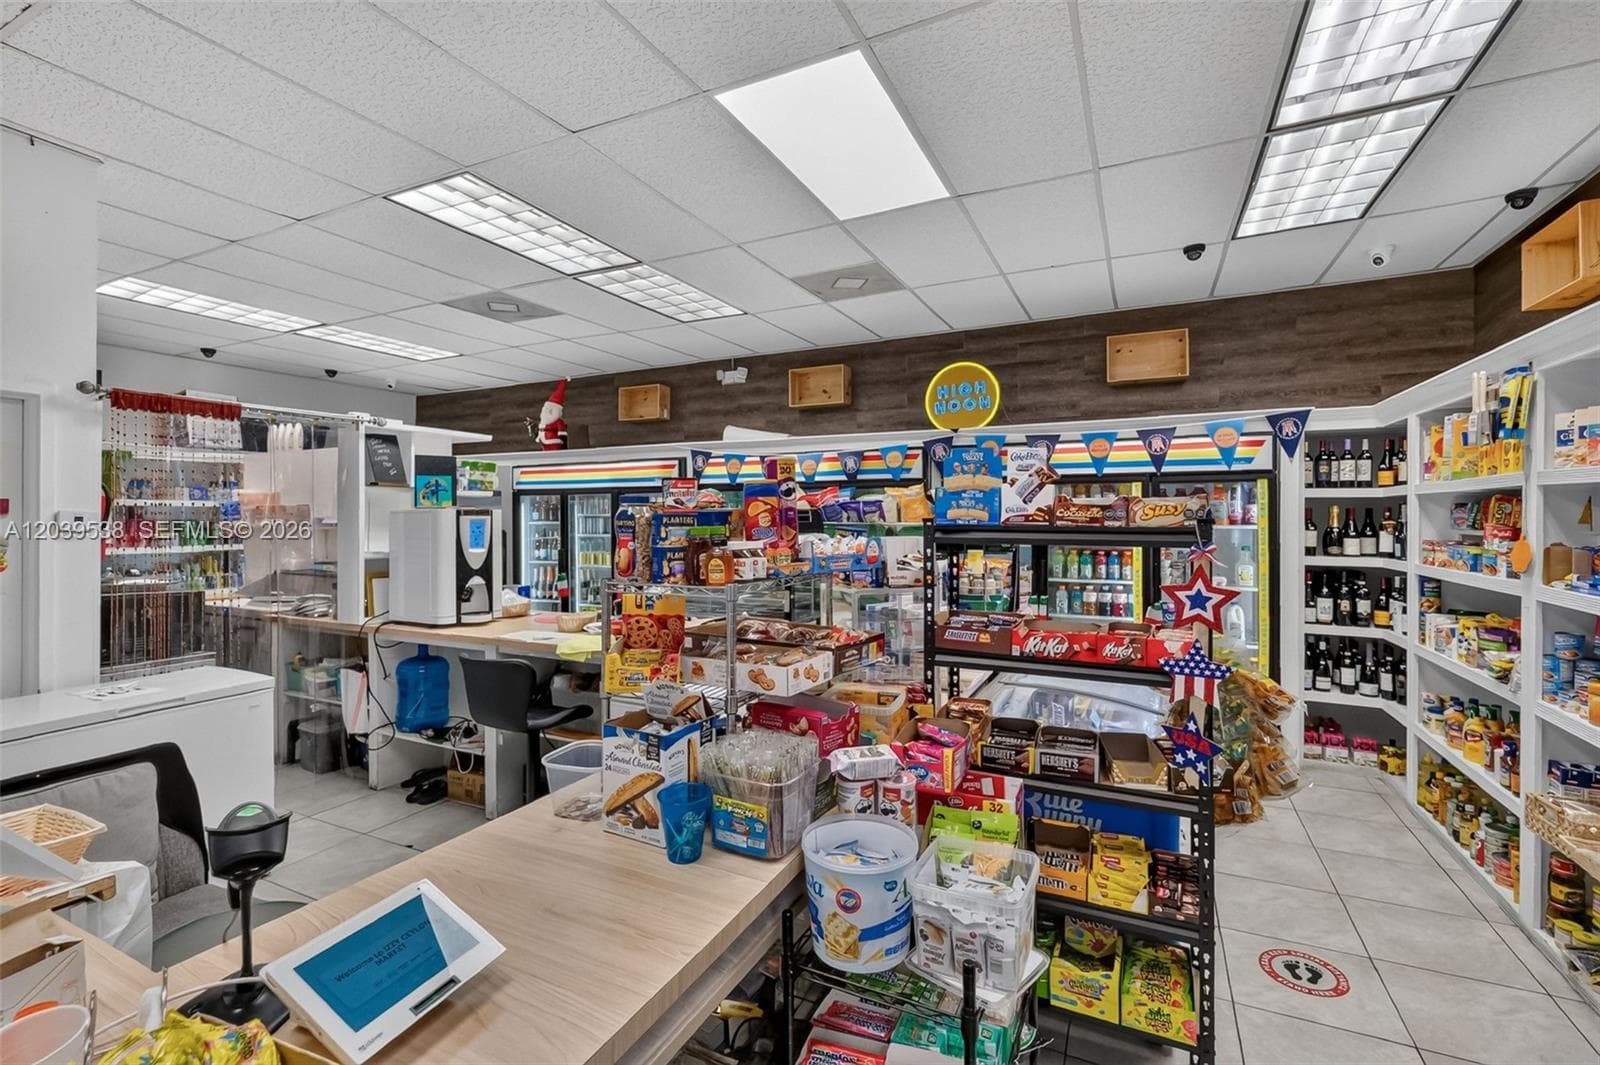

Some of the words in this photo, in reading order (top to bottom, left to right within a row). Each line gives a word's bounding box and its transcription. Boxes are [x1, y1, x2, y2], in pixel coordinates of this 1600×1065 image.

[937, 381, 987, 399] HIGH
[1139, 503, 1187, 521] Susy
[1041, 753, 1079, 769] HERSHEY'S
[989, 802, 1004, 814] 32
